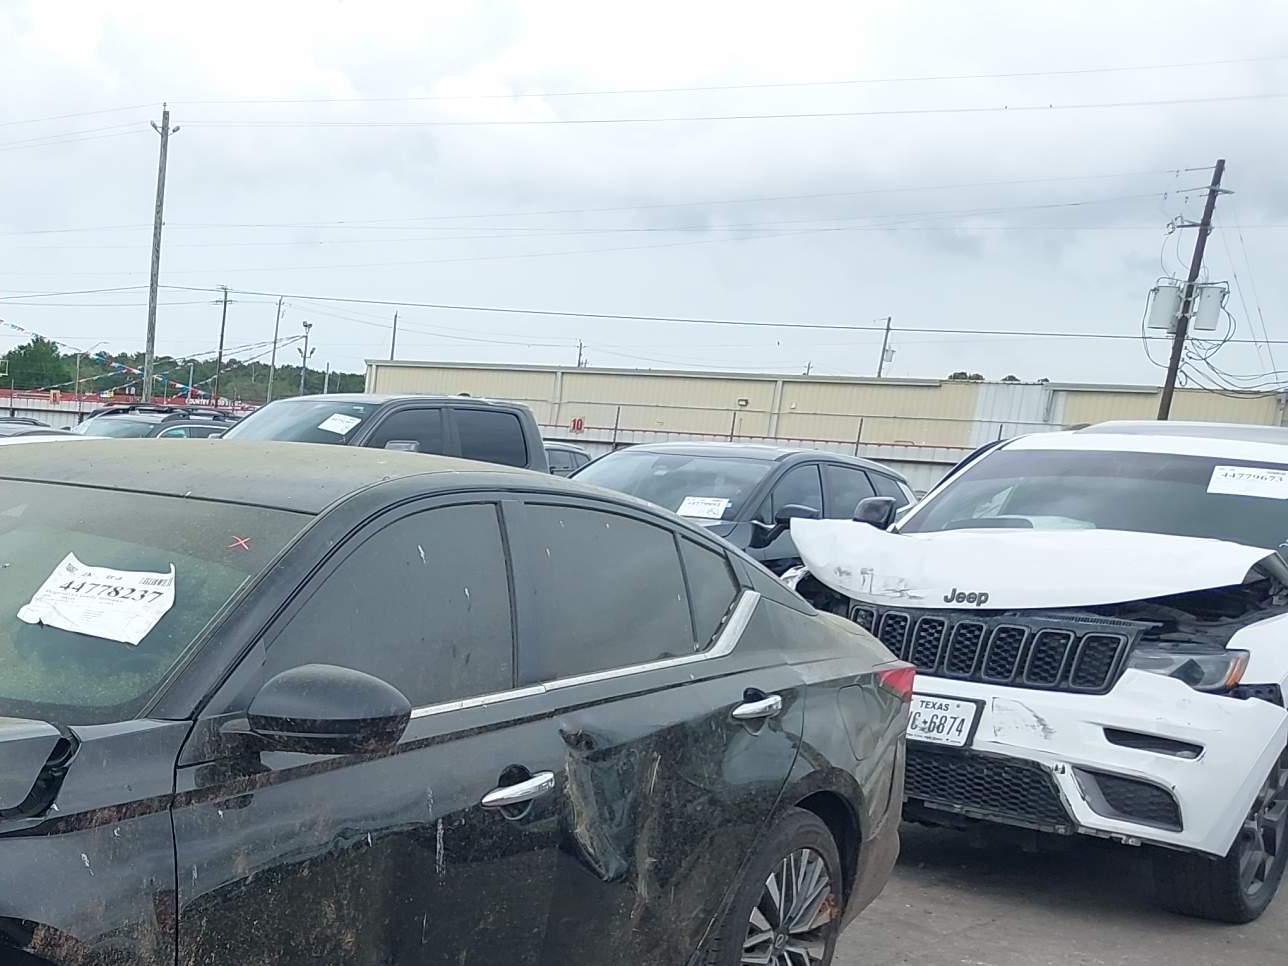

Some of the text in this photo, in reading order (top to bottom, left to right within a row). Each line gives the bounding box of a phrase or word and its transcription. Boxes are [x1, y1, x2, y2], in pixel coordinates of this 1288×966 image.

[572, 418, 583, 431] 10
[59, 581, 164, 603] 44778237
[943, 588, 990, 607] Jeep
[919, 700, 950, 712] TEXAS
[927, 713, 966, 737] 6874
